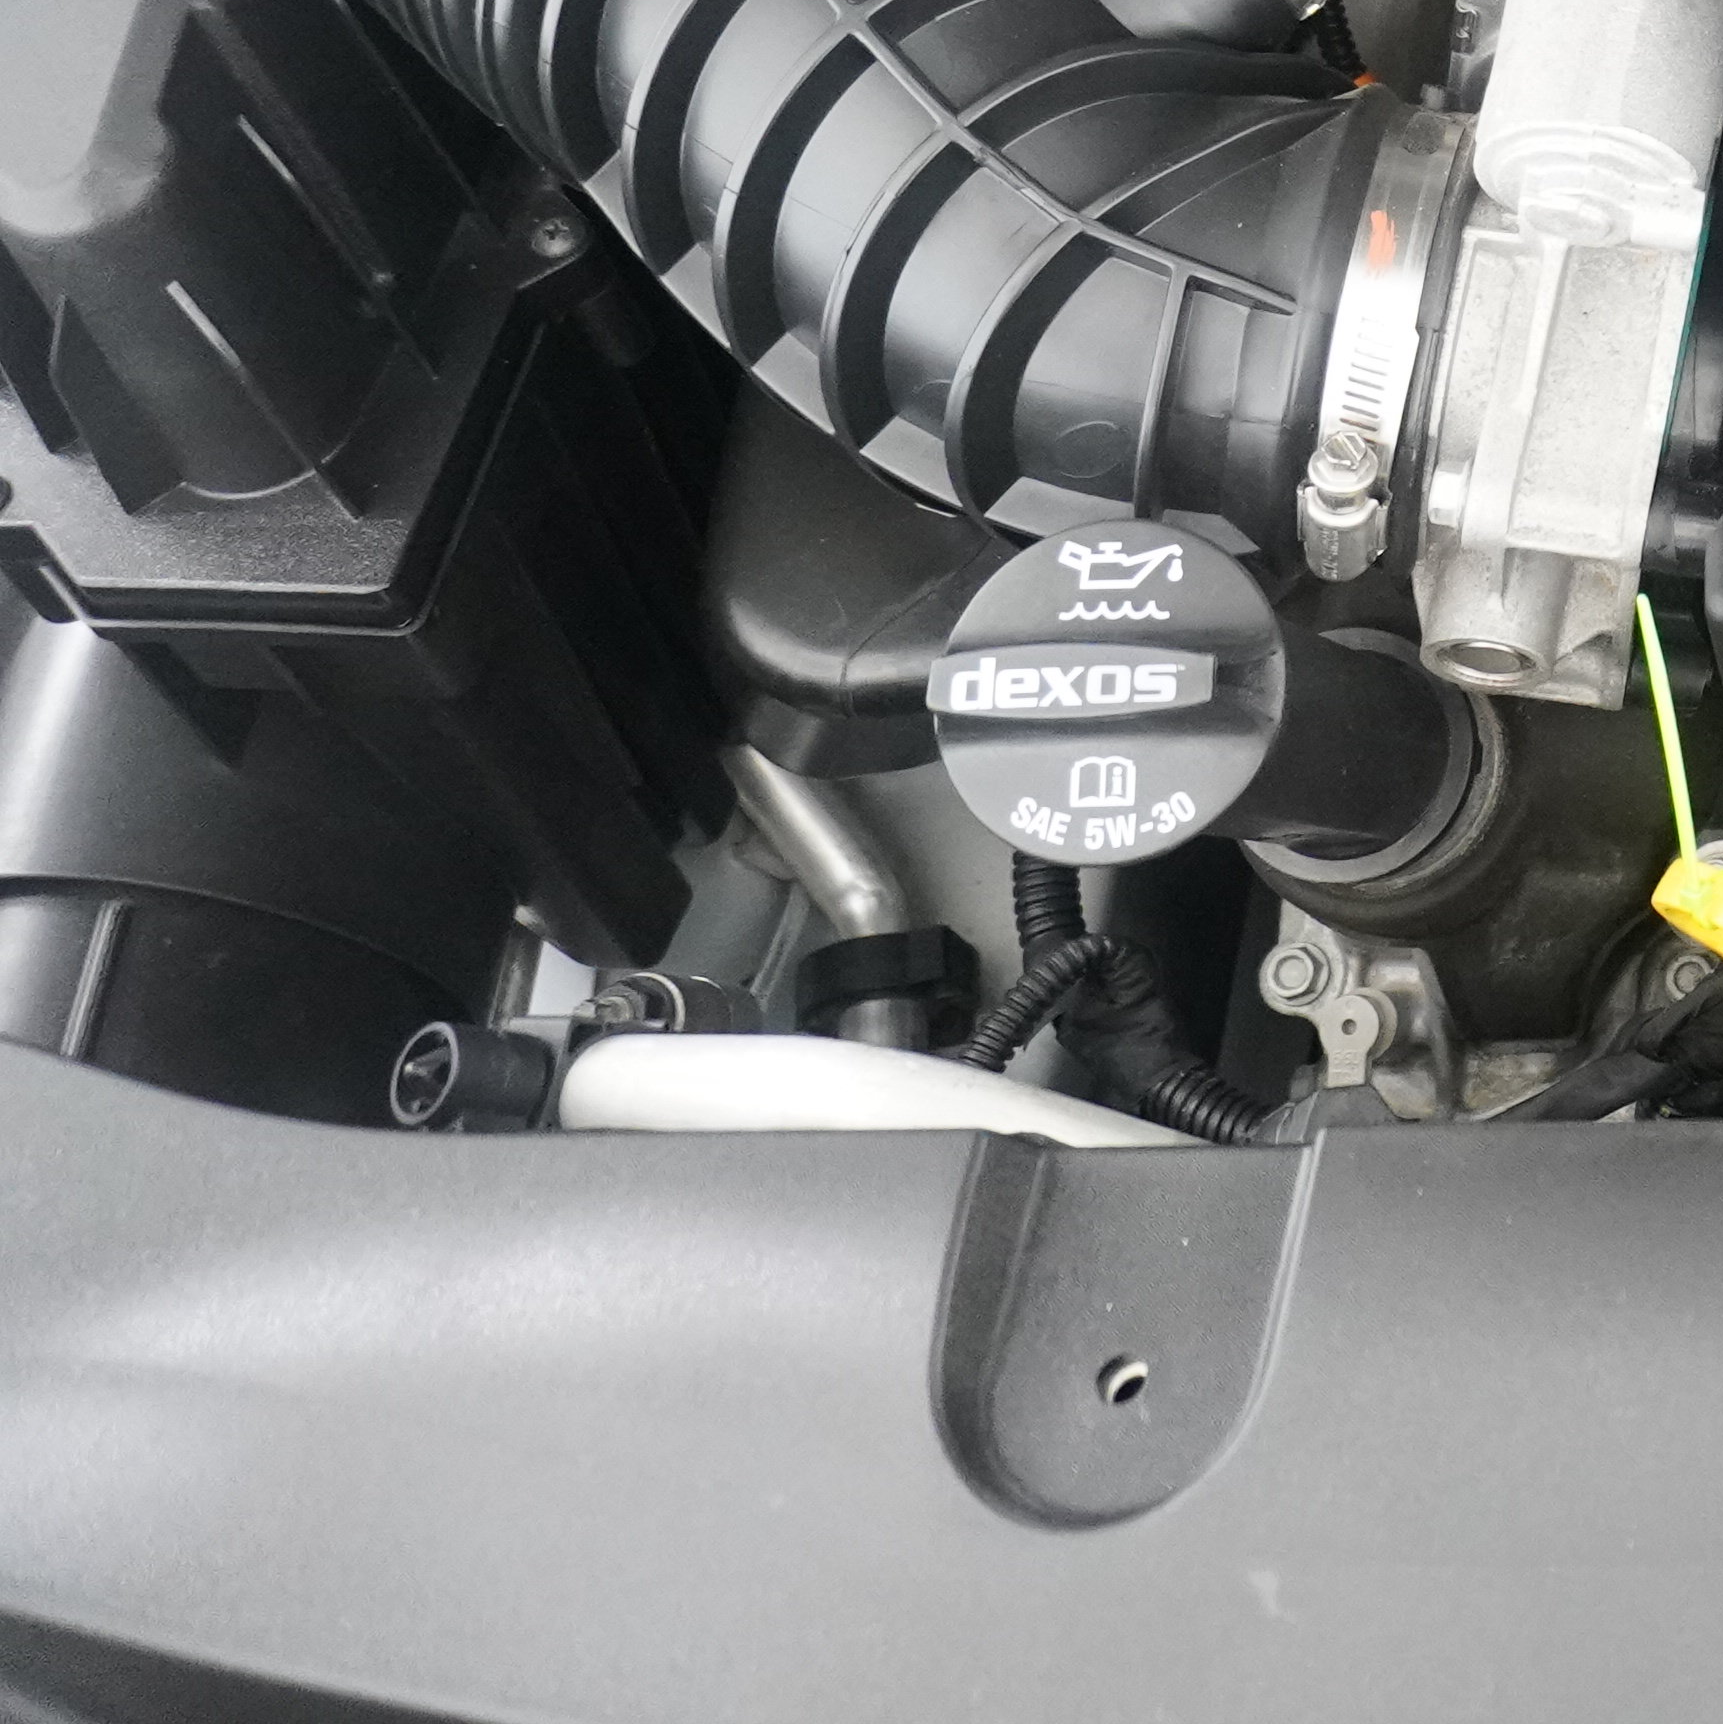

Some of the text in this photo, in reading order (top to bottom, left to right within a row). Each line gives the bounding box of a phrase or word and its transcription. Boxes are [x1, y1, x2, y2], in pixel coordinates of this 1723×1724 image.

[949, 656, 1179, 711] dexos
[1010, 789, 1197, 851] SAE 5W-30
